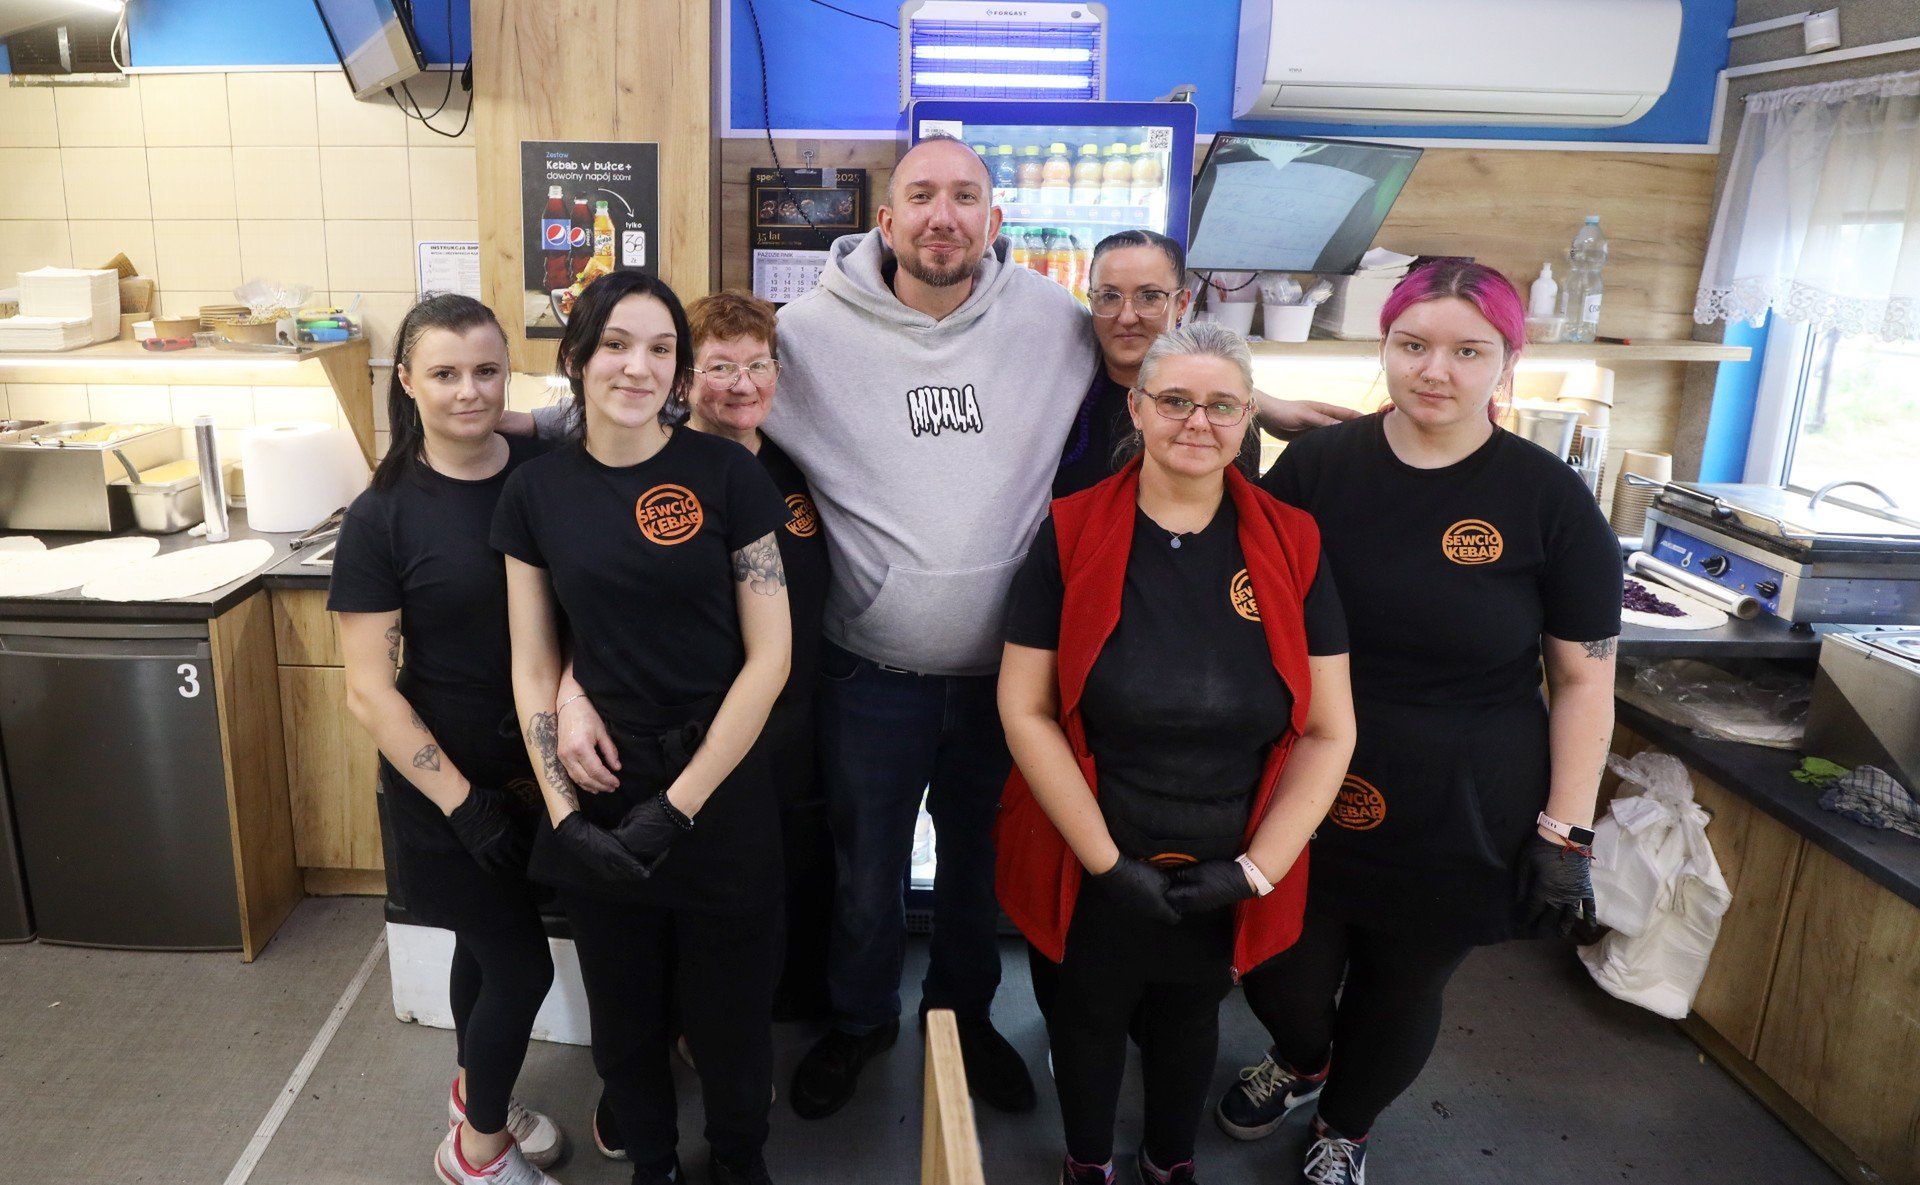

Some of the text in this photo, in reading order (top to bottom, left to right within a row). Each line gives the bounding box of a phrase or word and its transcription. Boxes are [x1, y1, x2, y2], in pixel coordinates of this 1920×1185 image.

[546, 160, 578, 170] Kebab
[581, 162, 591, 170] w
[546, 172, 583, 181] dowolny
[585, 173, 611, 182] napój
[625, 221, 642, 229] tylko
[640, 497, 697, 523] SEWCIO
[645, 511, 699, 536] KEBAB
[1446, 534, 1499, 546] SEWCIO
[1447, 546, 1498, 557] KEBAB
[177, 663, 200, 698] 3
